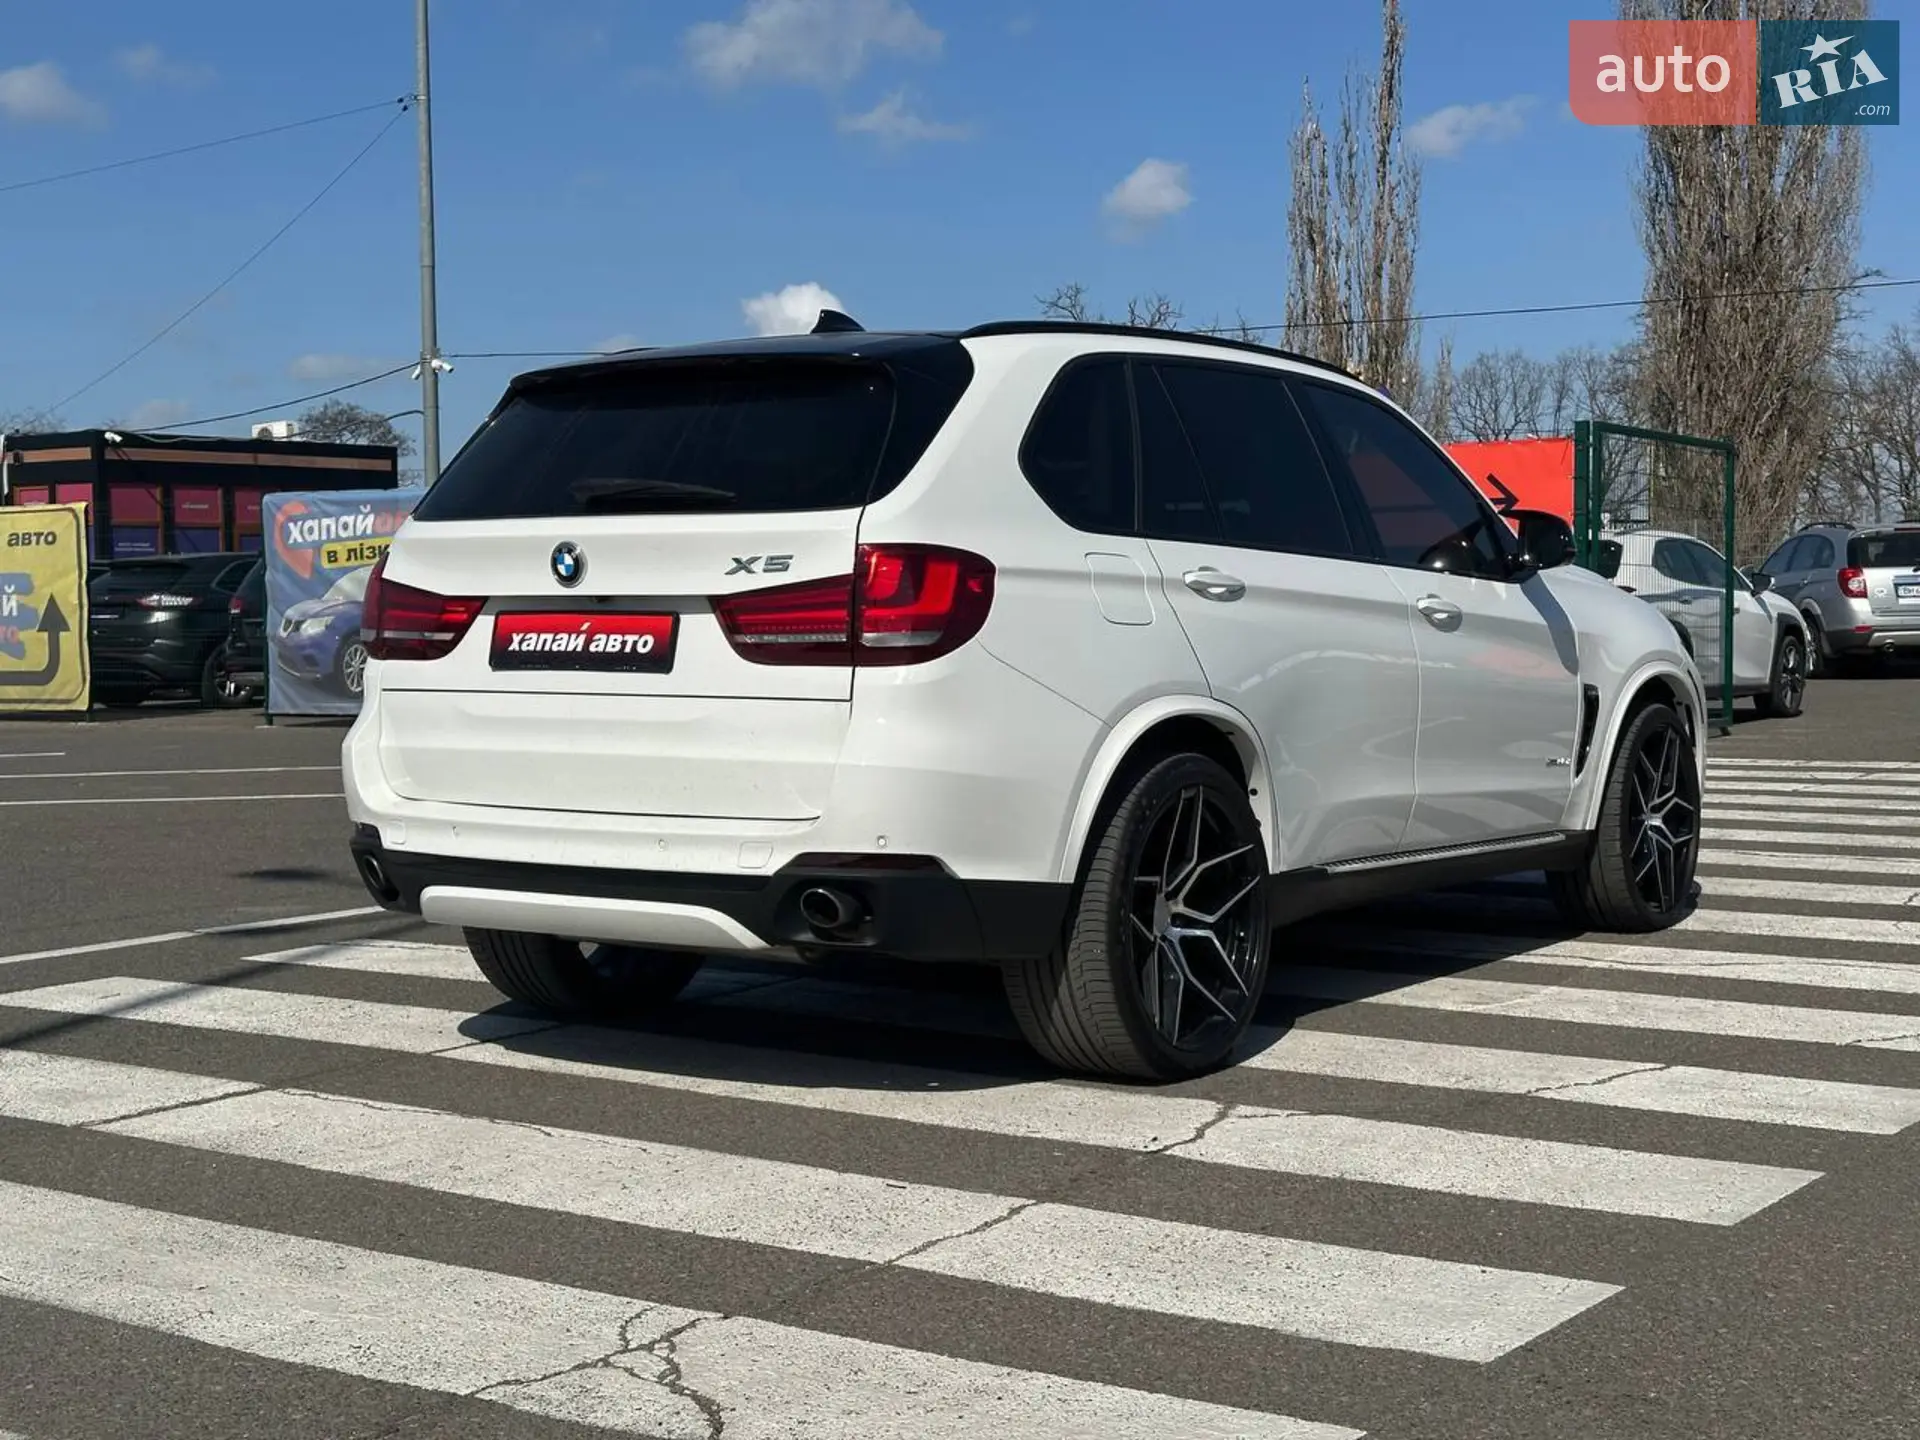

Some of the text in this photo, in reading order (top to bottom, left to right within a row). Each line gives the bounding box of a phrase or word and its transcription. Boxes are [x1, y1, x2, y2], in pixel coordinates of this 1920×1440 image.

[287, 503, 376, 545] хапай
[7, 531, 58, 547] авто
[326, 549, 338, 563] в
[724, 554, 794, 576] X5
[588, 633, 655, 653] авто
